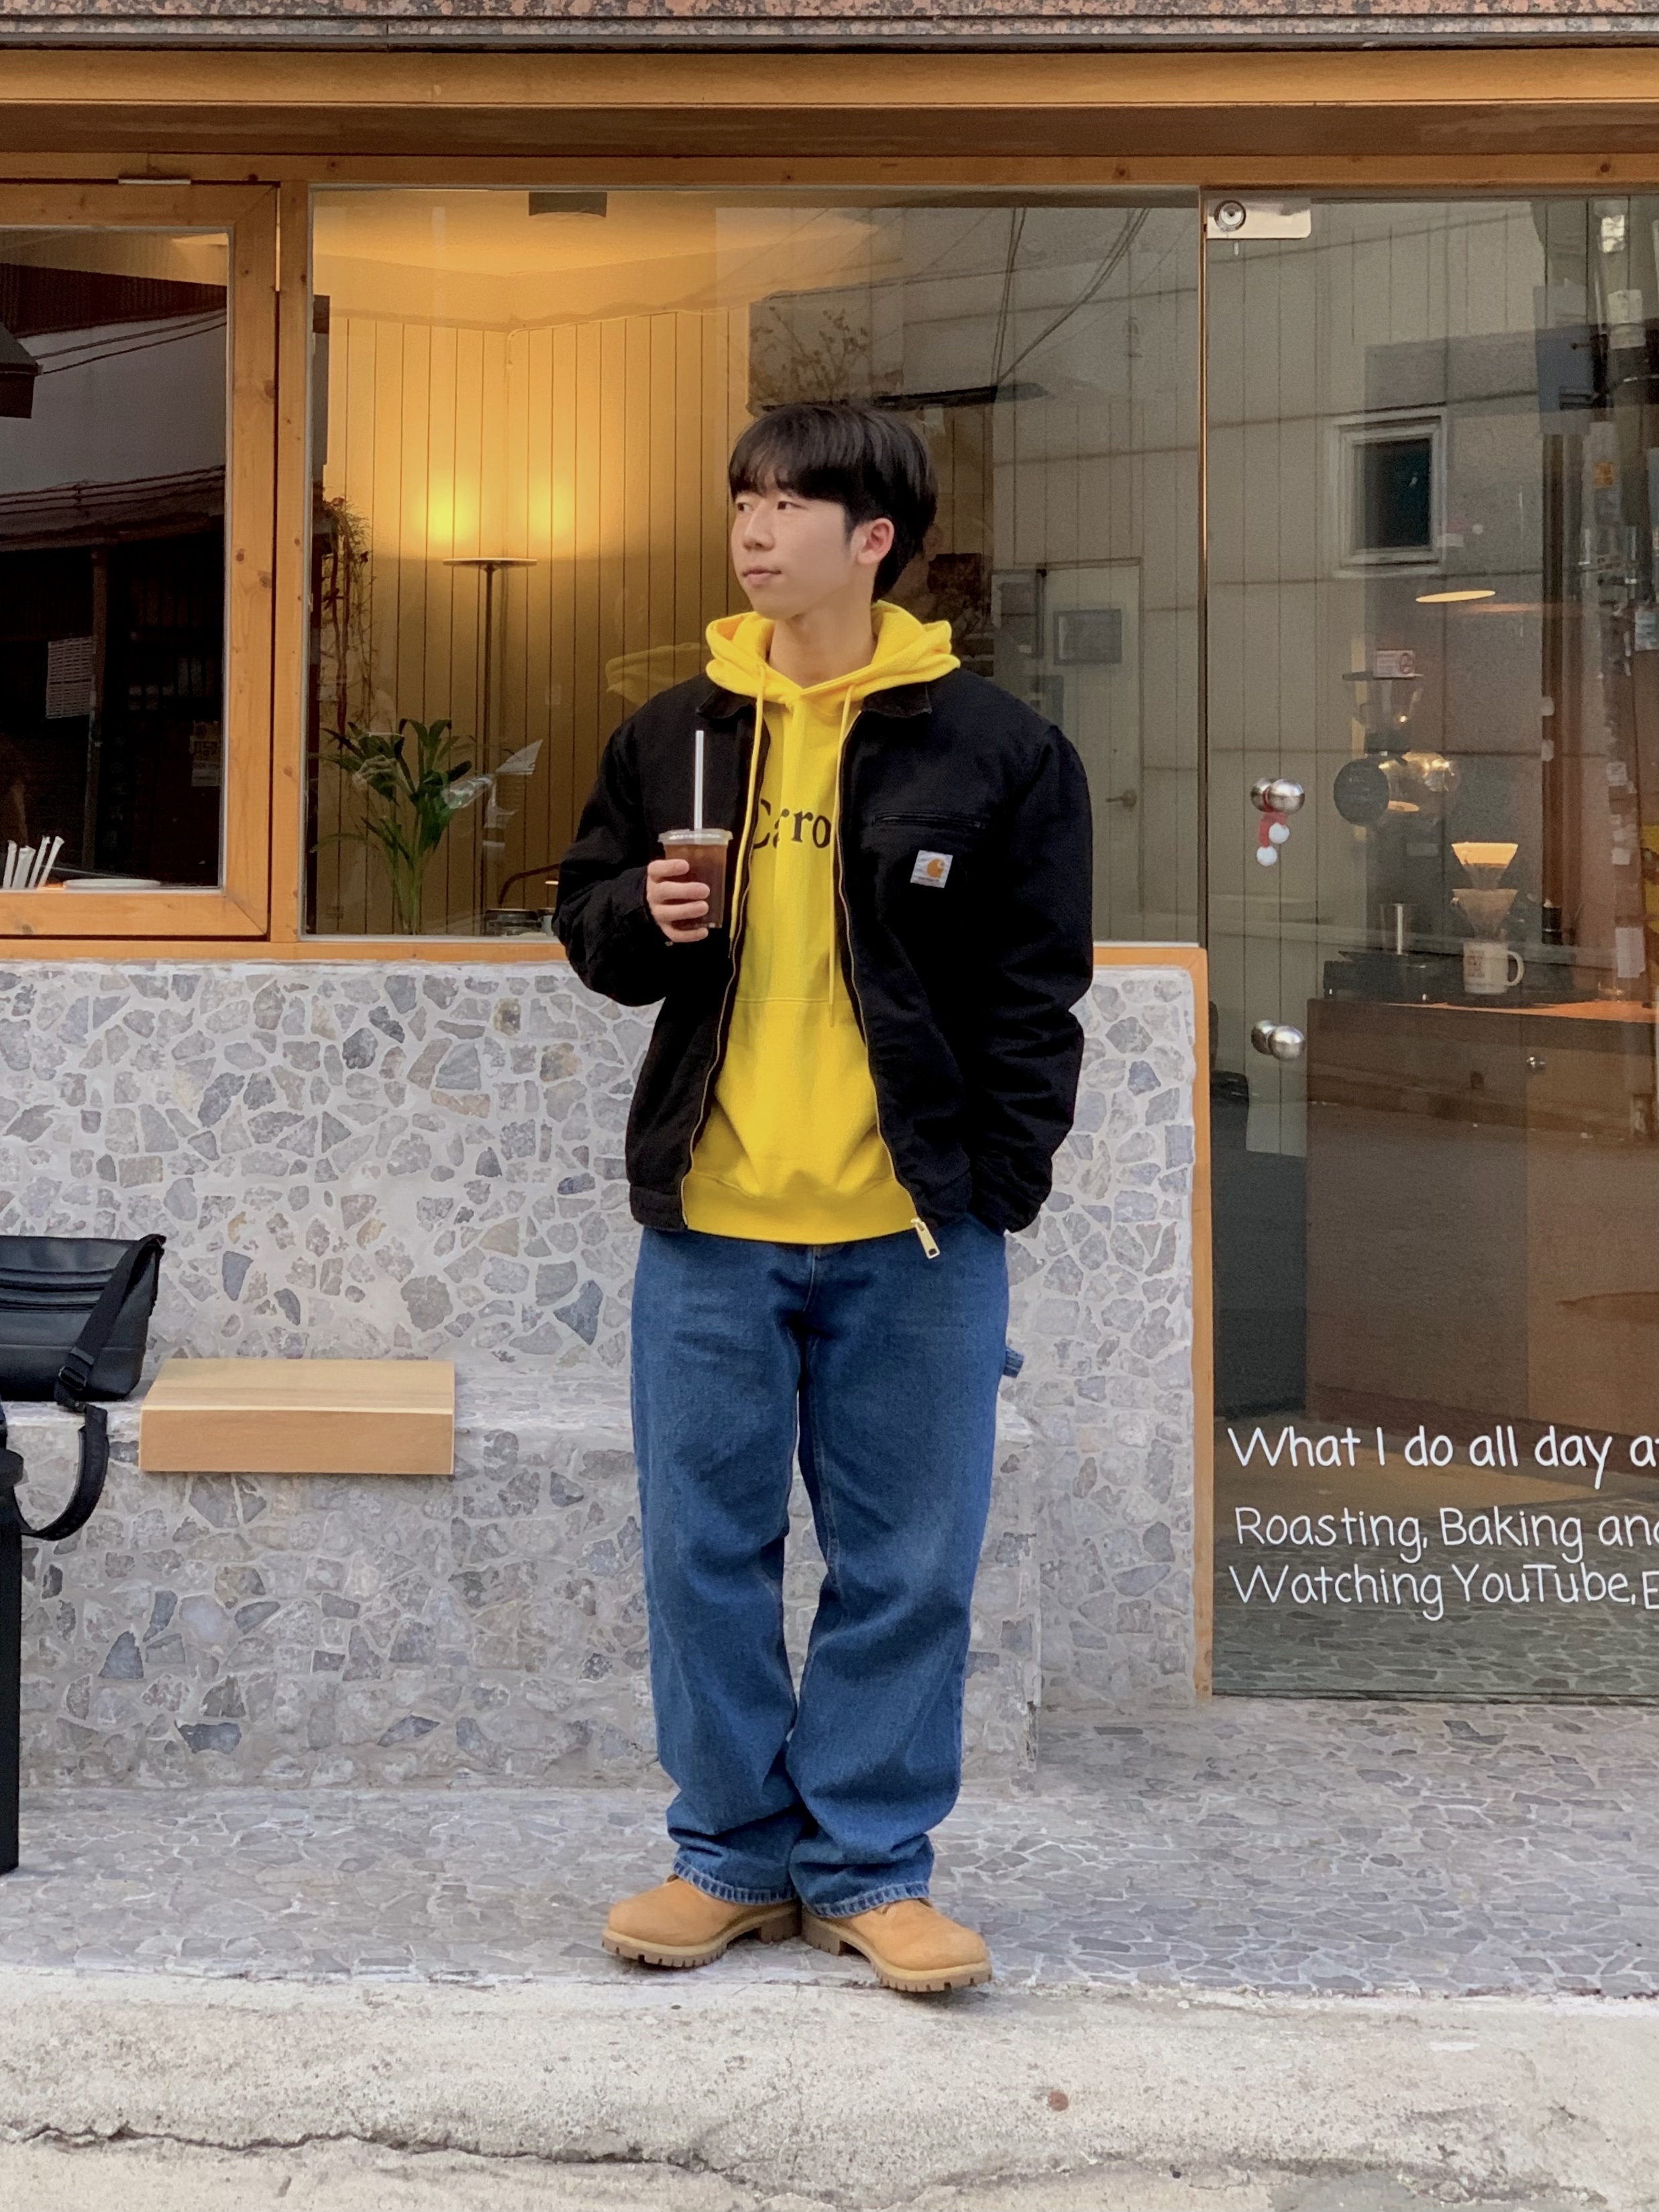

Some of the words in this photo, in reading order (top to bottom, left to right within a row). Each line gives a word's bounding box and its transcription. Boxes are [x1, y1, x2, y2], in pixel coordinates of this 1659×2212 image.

[1228, 1425, 1361, 1467] What
[1377, 1426, 1386, 1467] I
[1404, 1425, 1454, 1467] do
[1469, 1425, 1519, 1467] all
[1534, 1425, 1613, 1489] day
[1629, 1435, 1659, 1467] a
[1235, 1507, 1428, 1563] Roasting,
[1440, 1506, 1583, 1564] Baking
[1598, 1516, 1659, 1547] an
[1229, 1563, 1444, 1621] Watching
